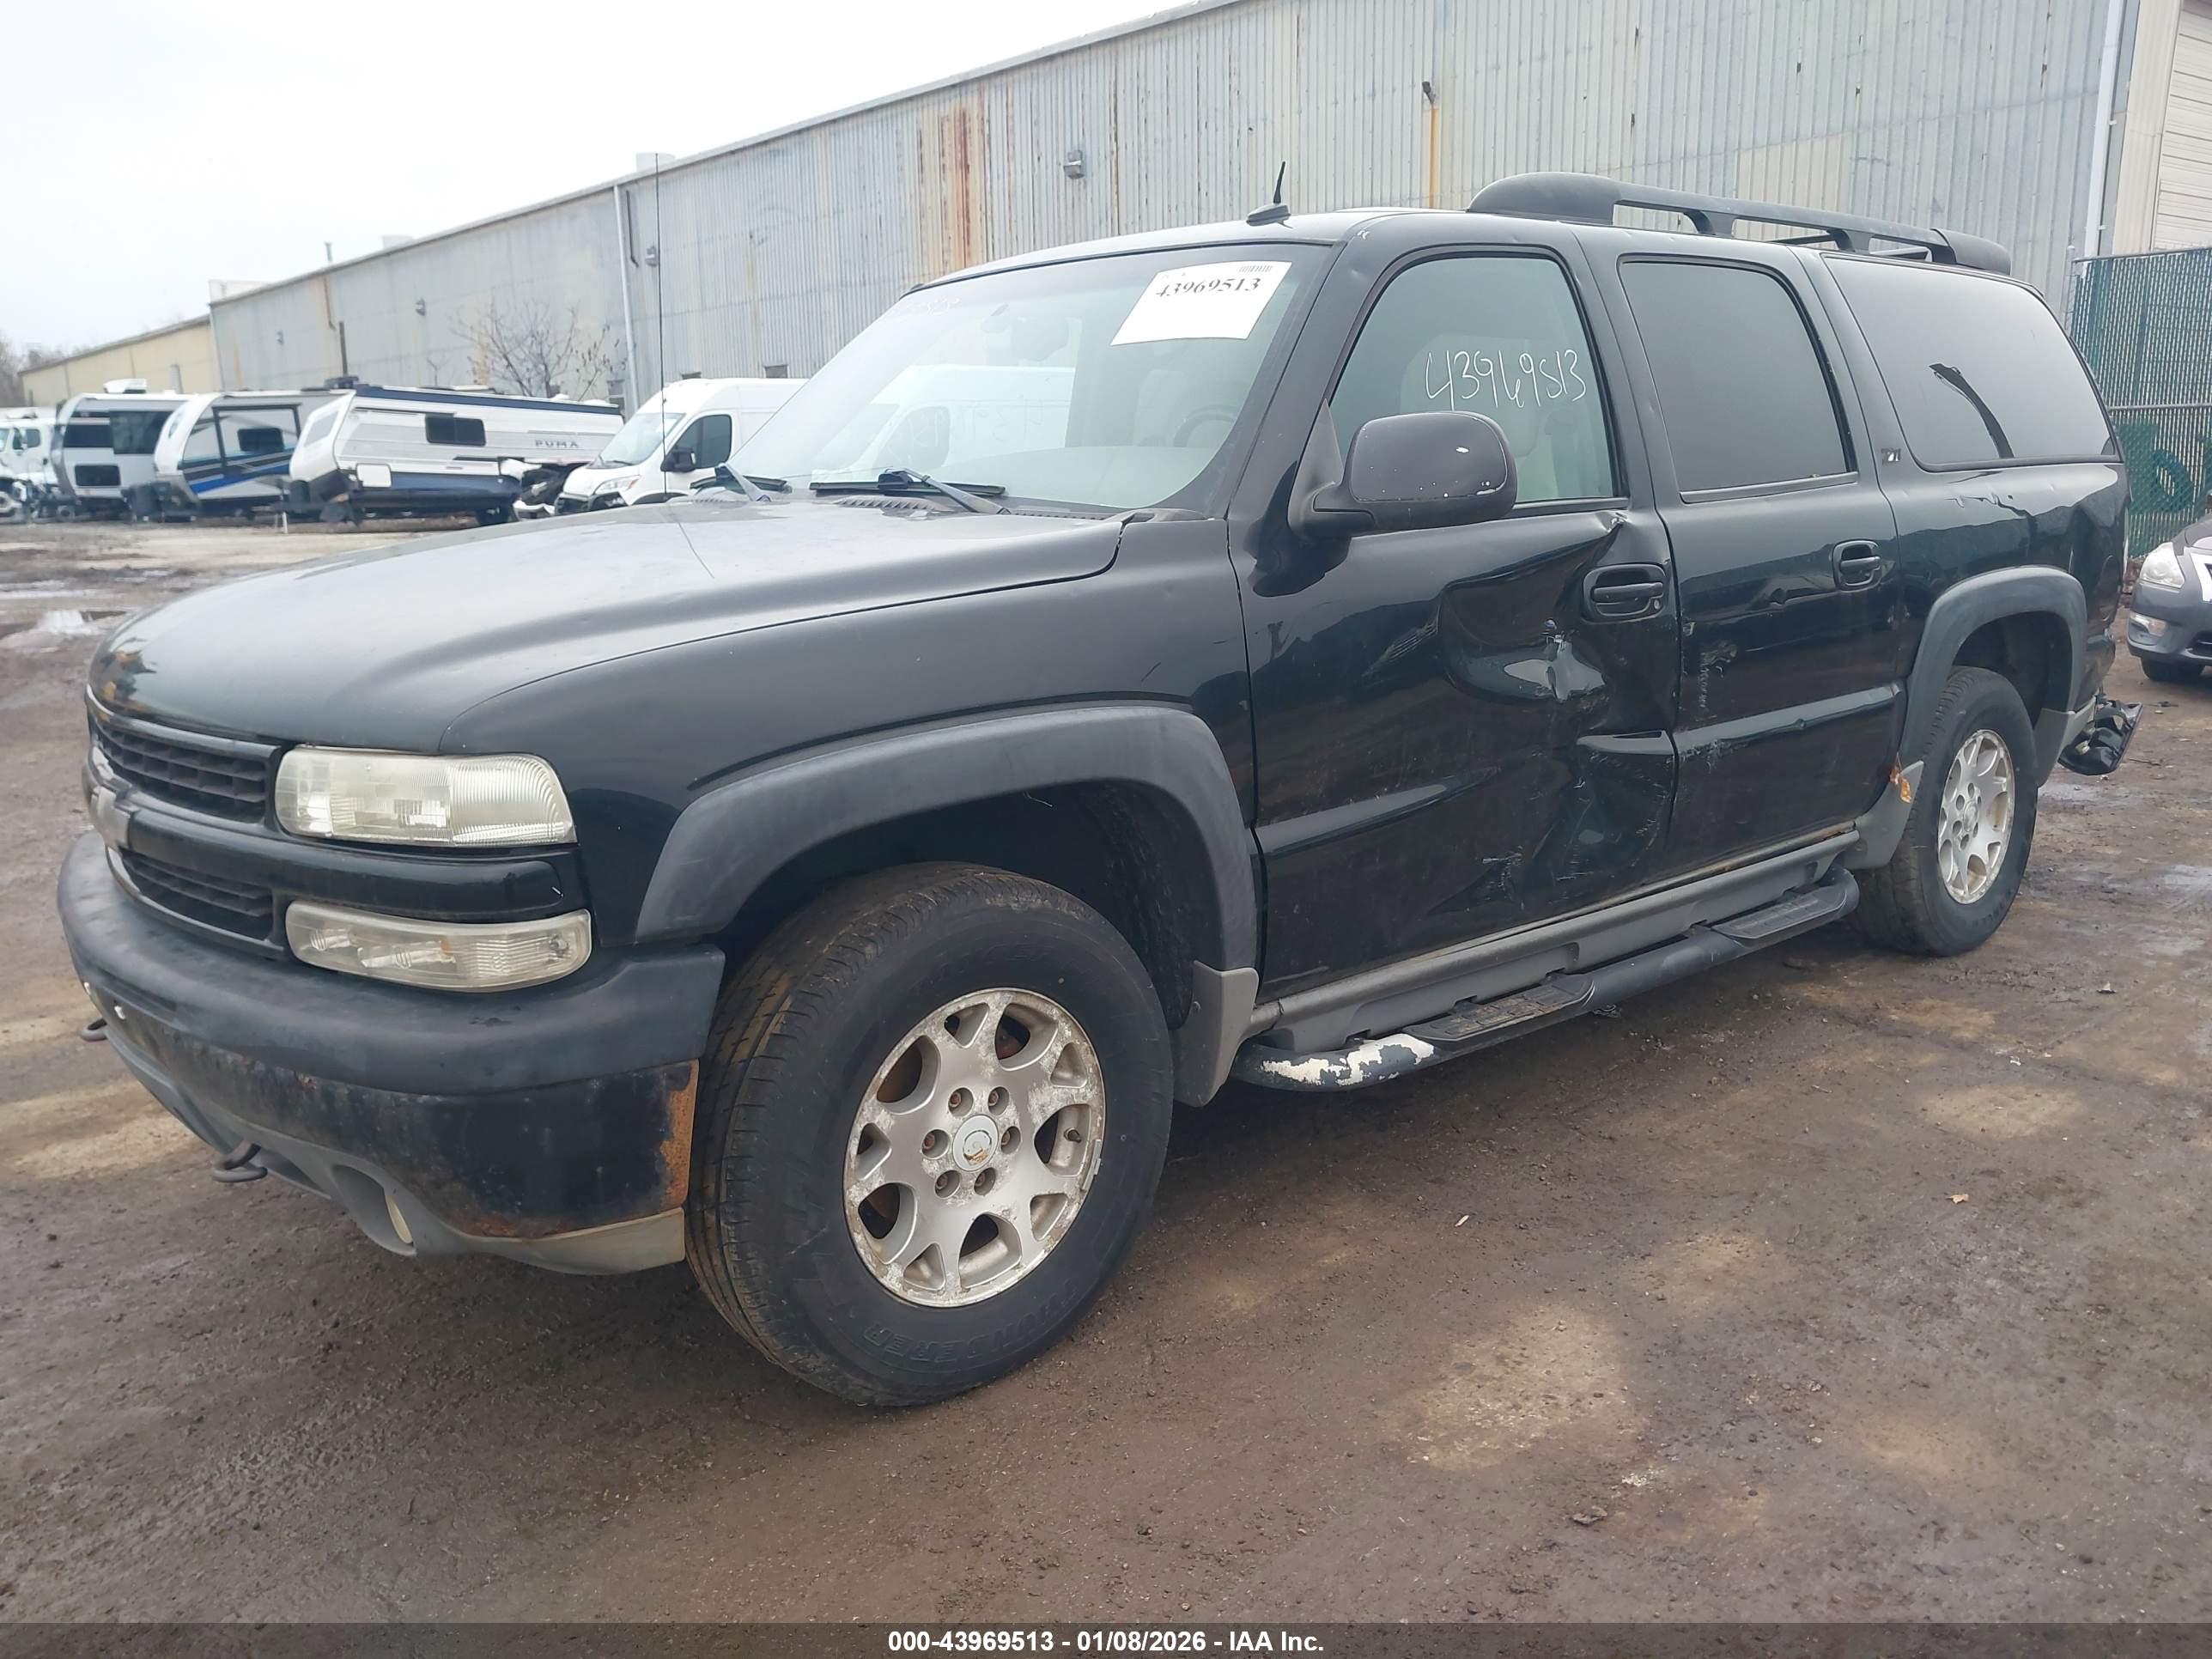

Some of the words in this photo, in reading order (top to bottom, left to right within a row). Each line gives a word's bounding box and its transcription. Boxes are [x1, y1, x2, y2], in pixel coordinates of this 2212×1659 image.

[1156, 277, 1261, 298] 43969513
[1425, 349, 1586, 411] 43969513
[535, 439, 579, 447] PUMA
